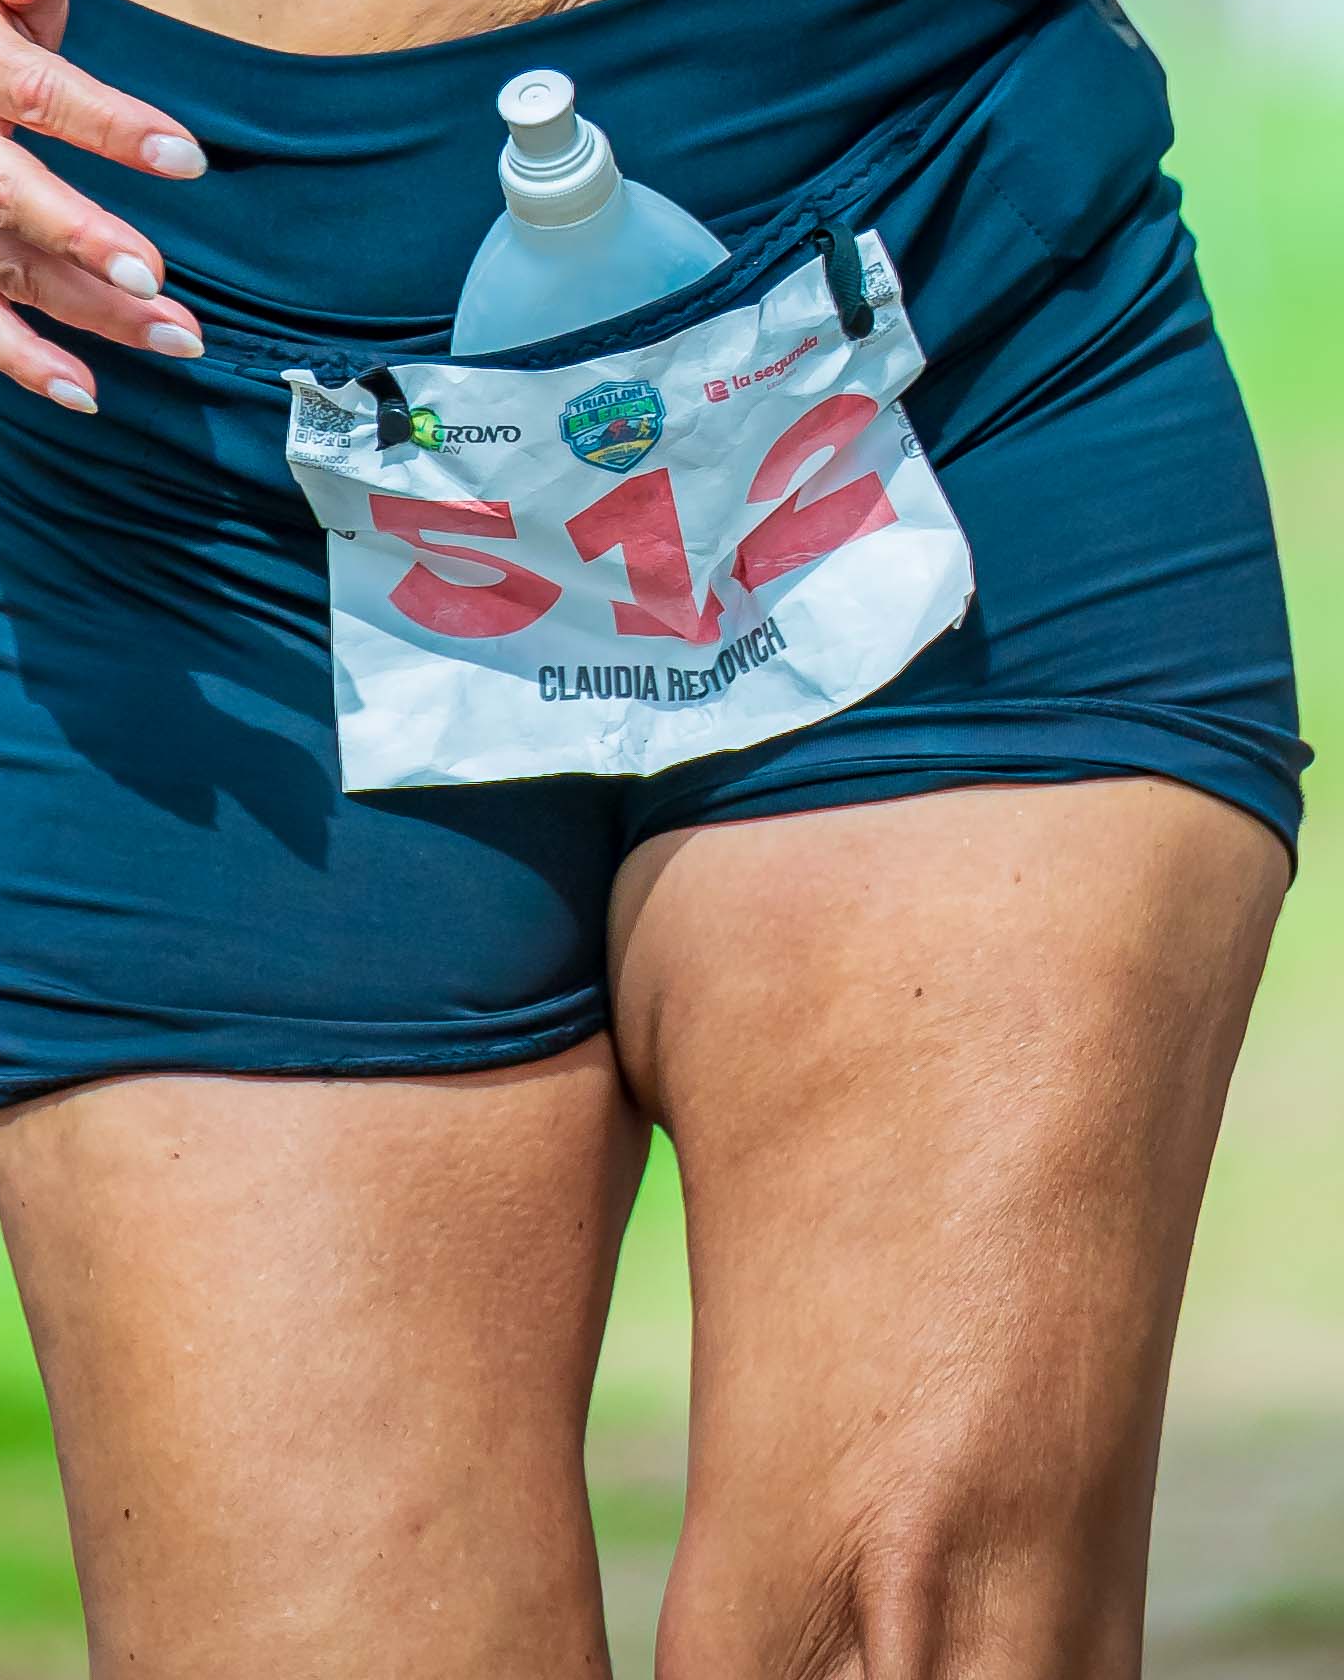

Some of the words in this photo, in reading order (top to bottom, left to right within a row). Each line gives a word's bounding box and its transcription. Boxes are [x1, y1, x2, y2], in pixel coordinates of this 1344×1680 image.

[732, 374, 751, 390] la
[754, 335, 819, 382] segunda
[570, 385, 648, 414] TRIATLON
[432, 424, 522, 444] CRONO
[569, 413, 597, 433] EL
[368, 393, 900, 645] 512
[538, 665, 659, 702] CLAUDIA
